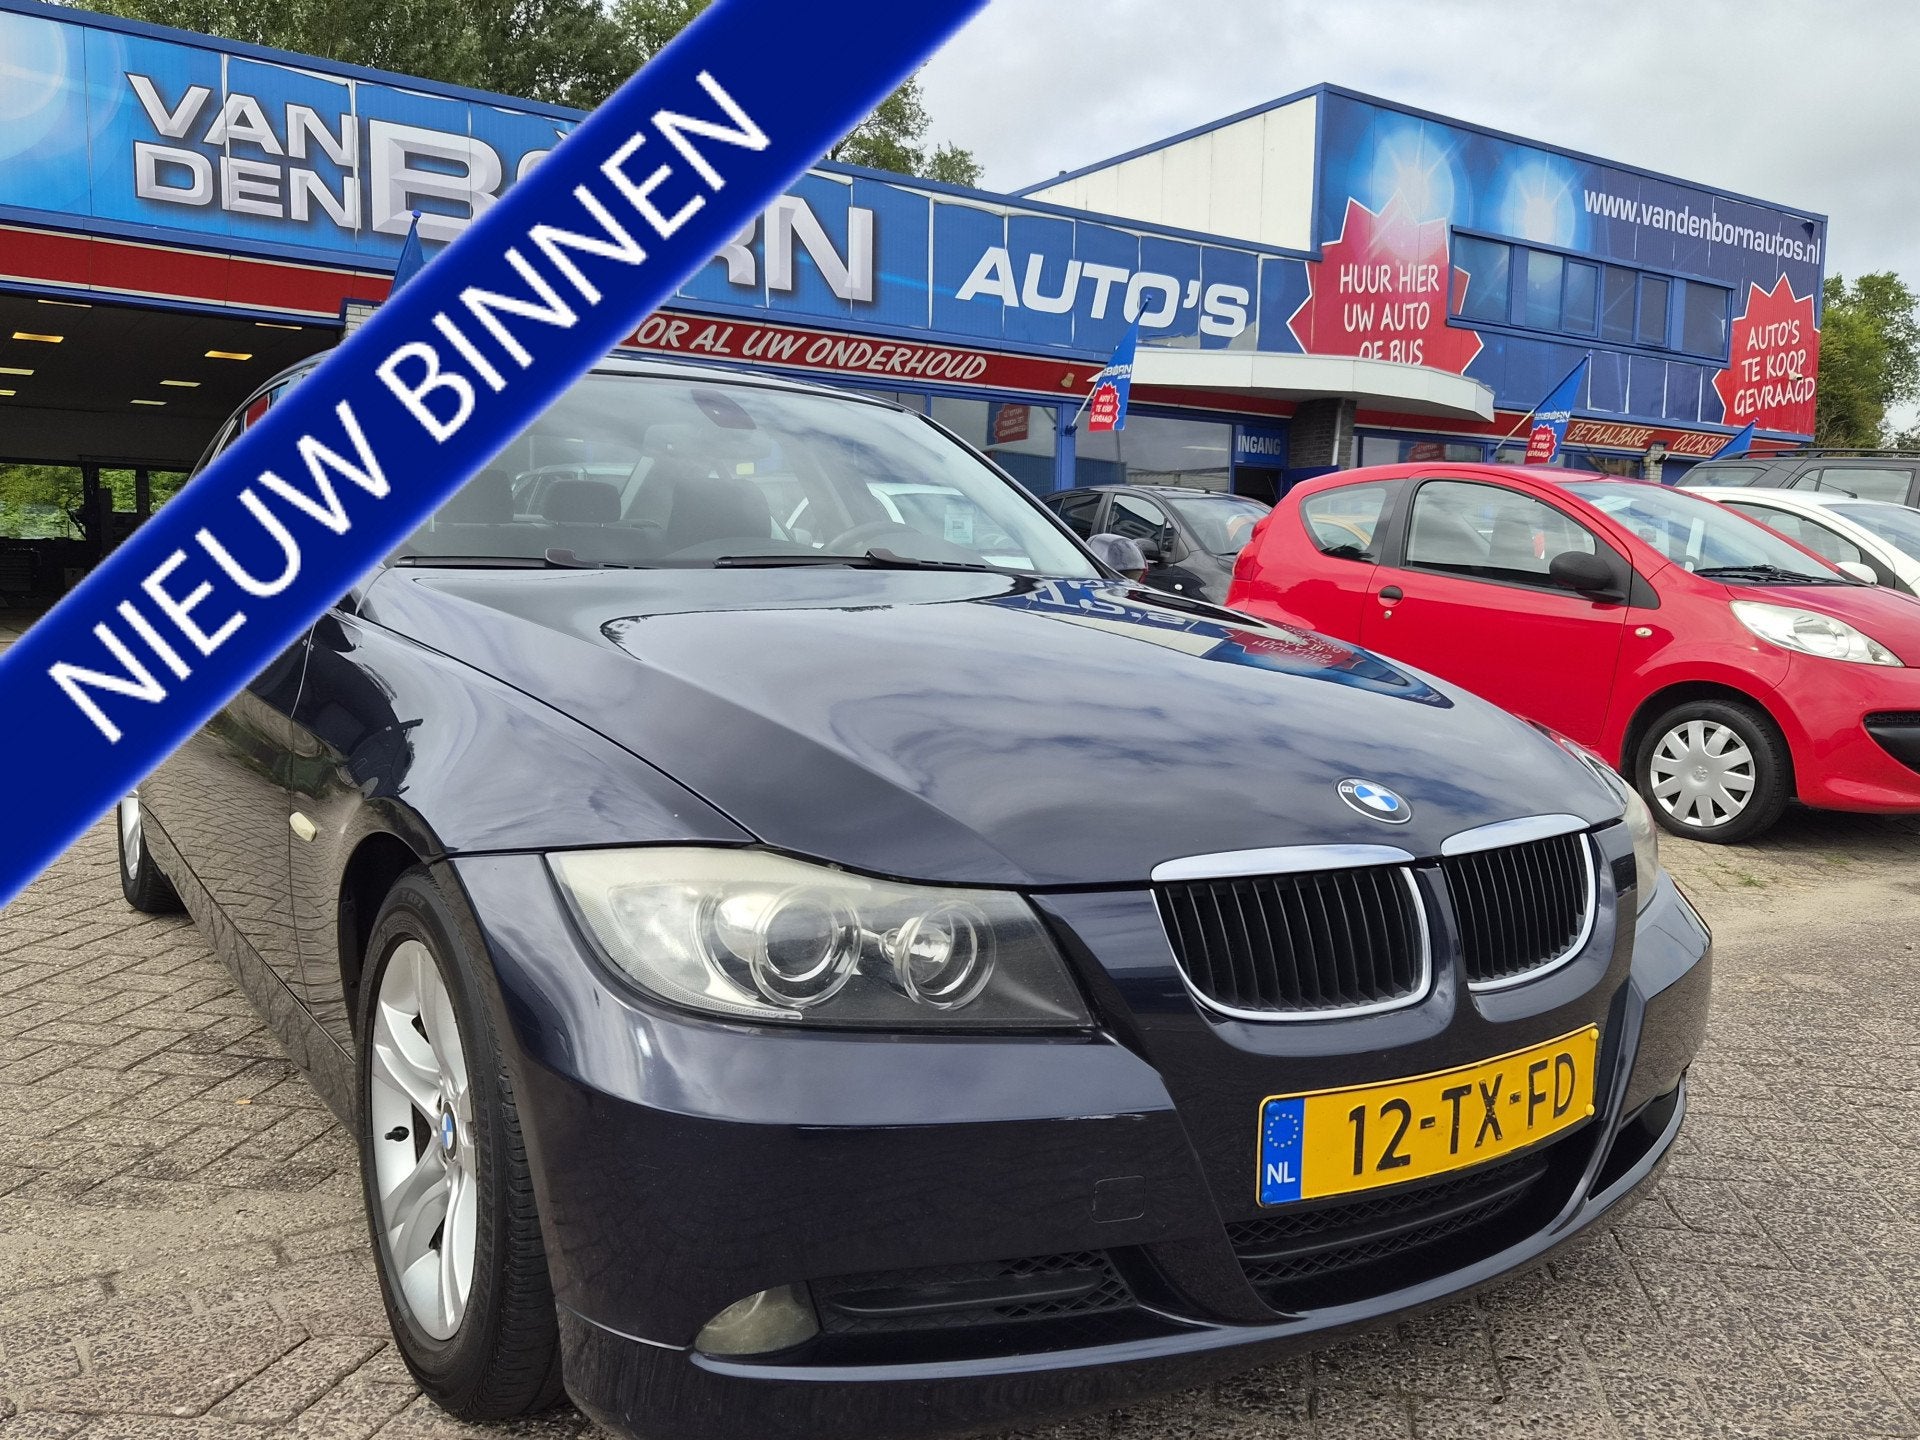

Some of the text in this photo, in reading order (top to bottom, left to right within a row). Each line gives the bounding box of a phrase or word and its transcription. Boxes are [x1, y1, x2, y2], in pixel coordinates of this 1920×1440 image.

[125, 72, 360, 168] VAN
[133, 139, 362, 231] DEN
[1583, 189, 1821, 265] www.vandenbornautos.nl
[954, 245, 1251, 338] AUTO'S
[1339, 263, 1440, 295] HUUR HIER
[1343, 301, 1430, 333] UW AUTO
[1358, 338, 1424, 366] OF BUS
[1746, 319, 1801, 352] AUTO'S
[689, 325, 732, 354] AL
[741, 329, 808, 361] UW
[805, 337, 988, 381] ONDERHOUD
[1741, 349, 1807, 383] TE KOOP
[1734, 377, 1816, 418] GEVRAAGD
[1237, 434, 1281, 456] INGANG
[1566, 422, 1655, 447] BETAALBARE
[1348, 1051, 1577, 1176] 12-TX-FD
[1266, 1160, 1296, 1187] NL
